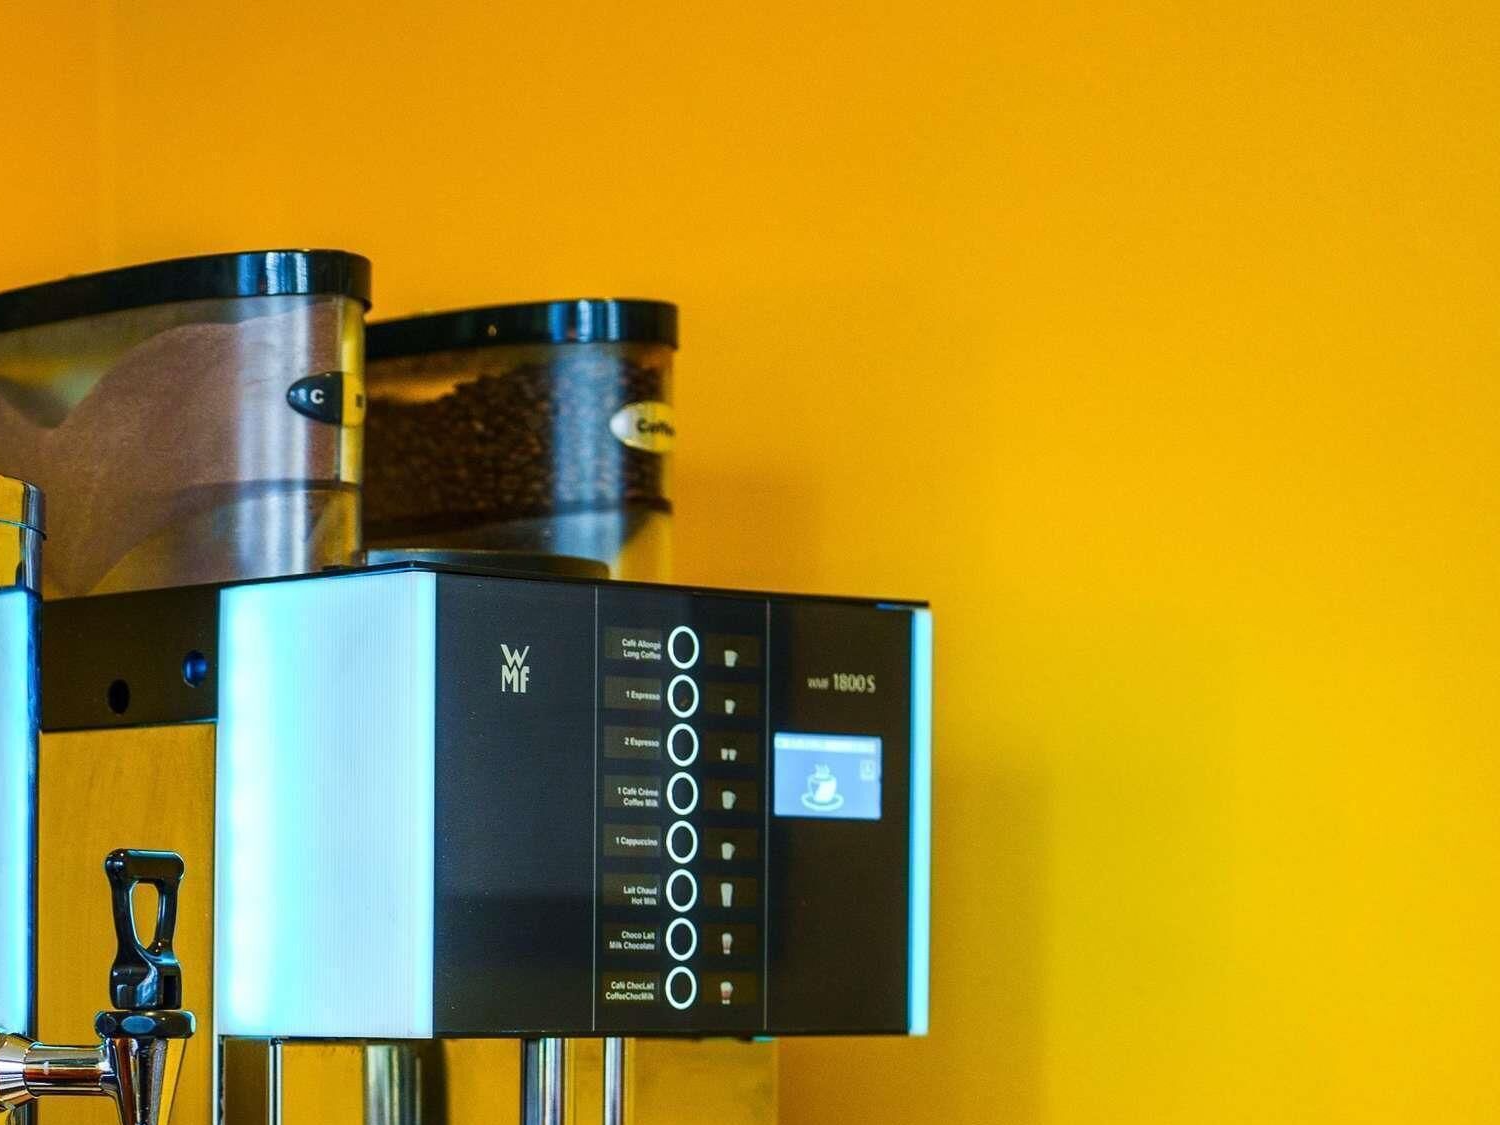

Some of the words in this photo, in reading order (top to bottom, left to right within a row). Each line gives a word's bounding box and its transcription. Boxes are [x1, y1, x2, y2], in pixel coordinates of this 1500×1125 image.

[623, 649, 640, 660] Long
[640, 650, 662, 660] Coffee
[500, 643, 530, 693] WMF
[631, 690, 661, 701] Espresso
[630, 737, 660, 748] Espresso
[623, 797, 644, 807] Coffee
[645, 798, 659, 808] Milk
[620, 837, 659, 847] Cappuccino
[623, 885, 636, 895] Lait
[636, 886, 658, 896] Chaud
[631, 897, 643, 906] Hot
[643, 897, 657, 906] Milk
[621, 931, 643, 940] Choco
[642, 931, 656, 941] Lait
[609, 940, 623, 950] Milk
[623, 941, 655, 951] Chocolate
[626, 981, 655, 991] ChocLait
